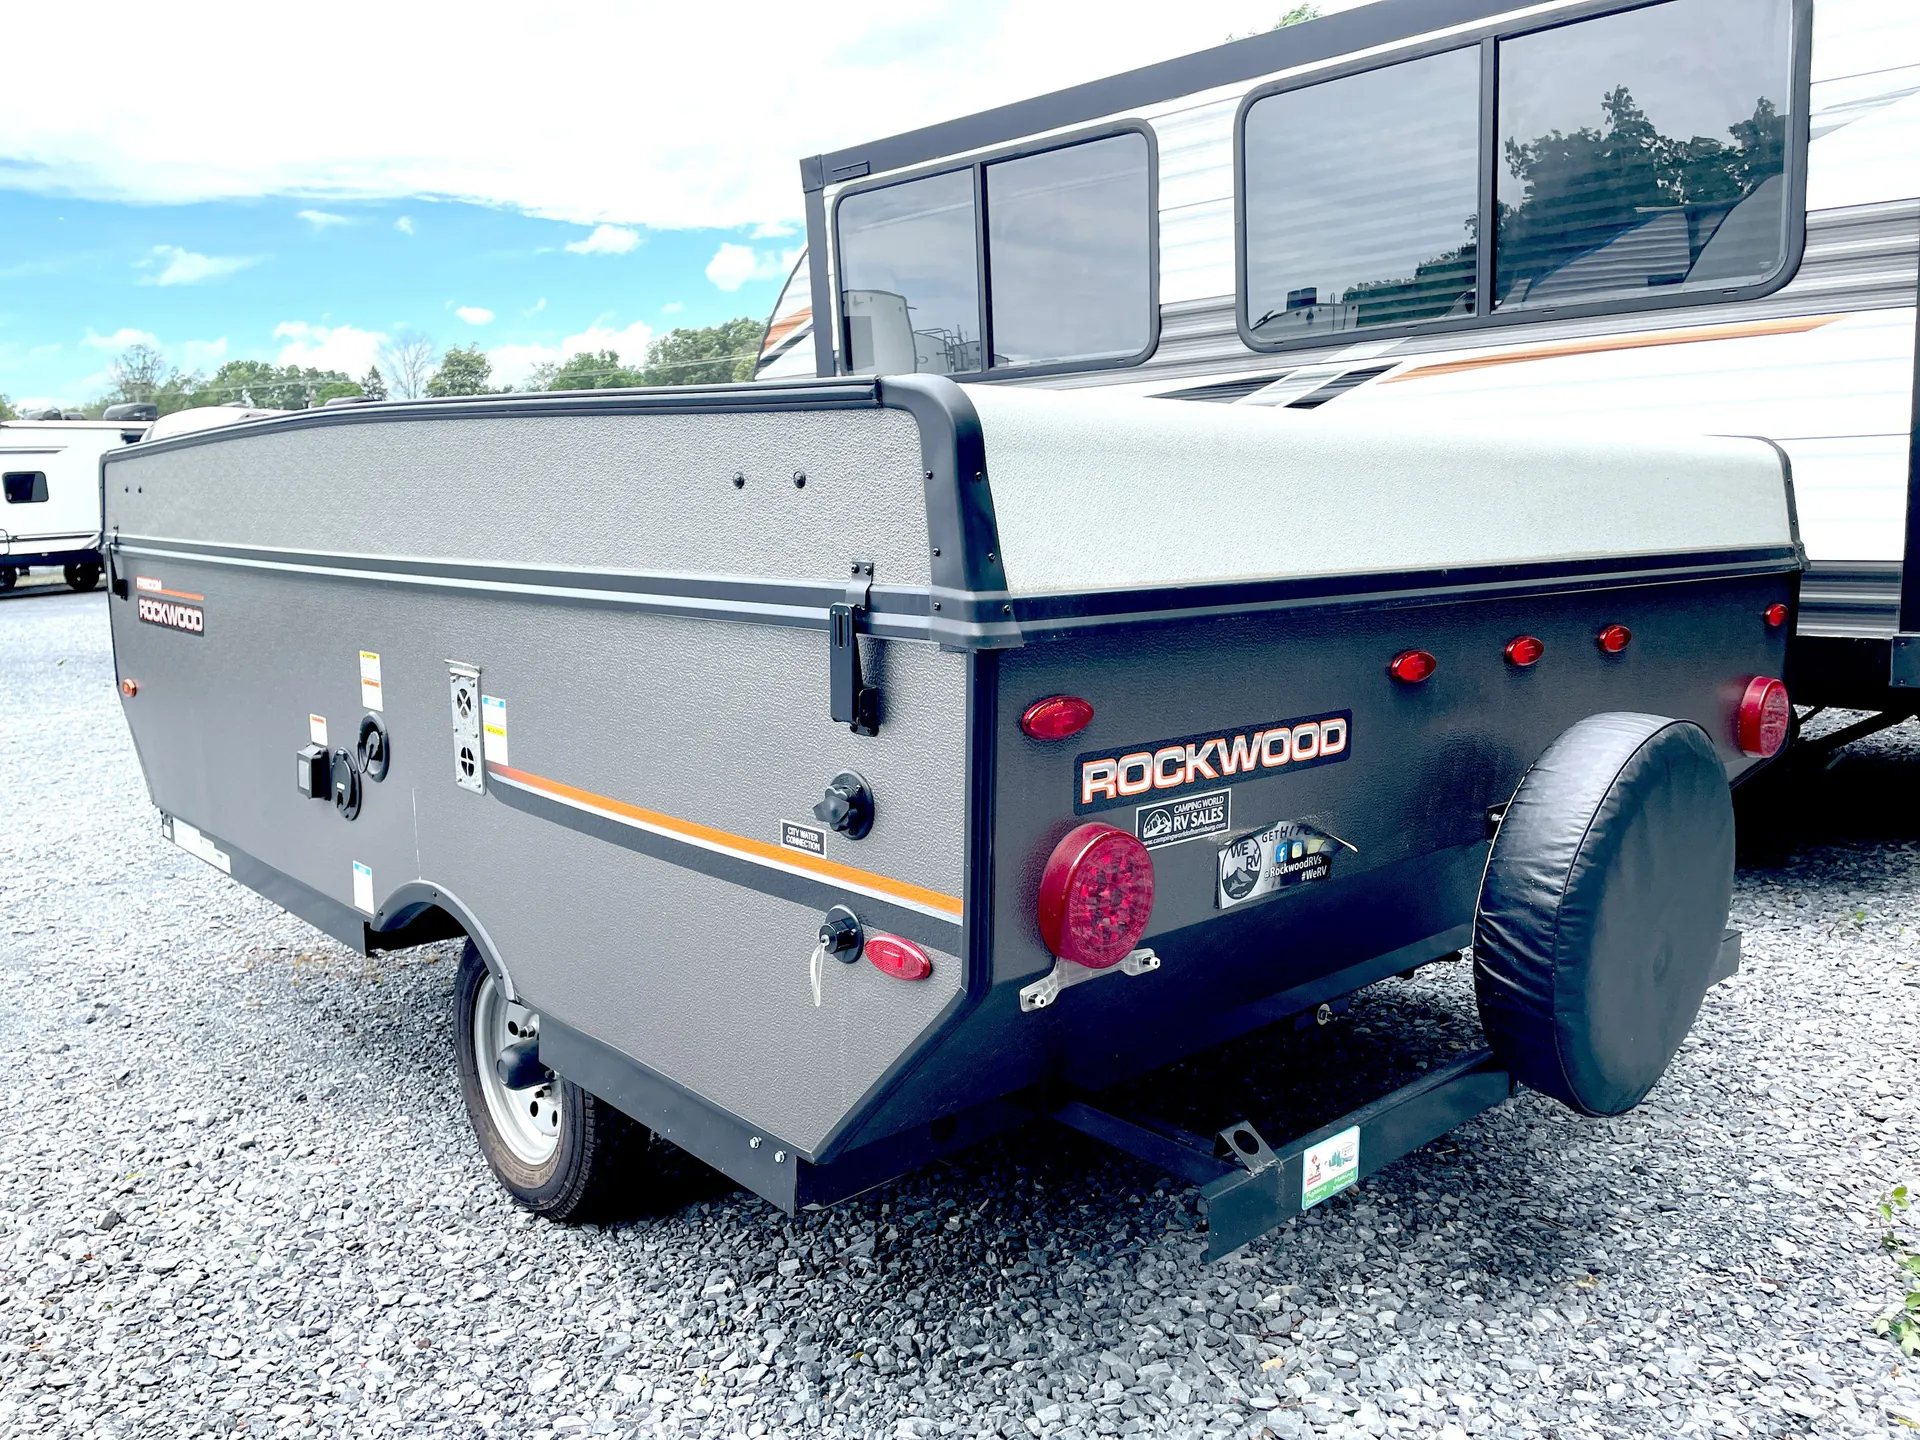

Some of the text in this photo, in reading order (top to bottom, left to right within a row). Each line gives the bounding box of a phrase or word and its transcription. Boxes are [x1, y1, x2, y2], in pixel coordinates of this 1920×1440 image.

[139, 598, 203, 632] ROCKWOOD
[1081, 717, 1347, 804] ROCKWOOD
[1173, 795, 1224, 814] CAMPING WORLD
[1173, 806, 1224, 832] RV SALES
[786, 835, 820, 851] CONNECTION
[788, 827, 818, 841] CITY WATER
[1230, 841, 1249, 859] WE
[1246, 853, 1260, 868] RV
[1264, 854, 1323, 882] @RockwoodRVs
[1301, 865, 1328, 882] #WeRV
